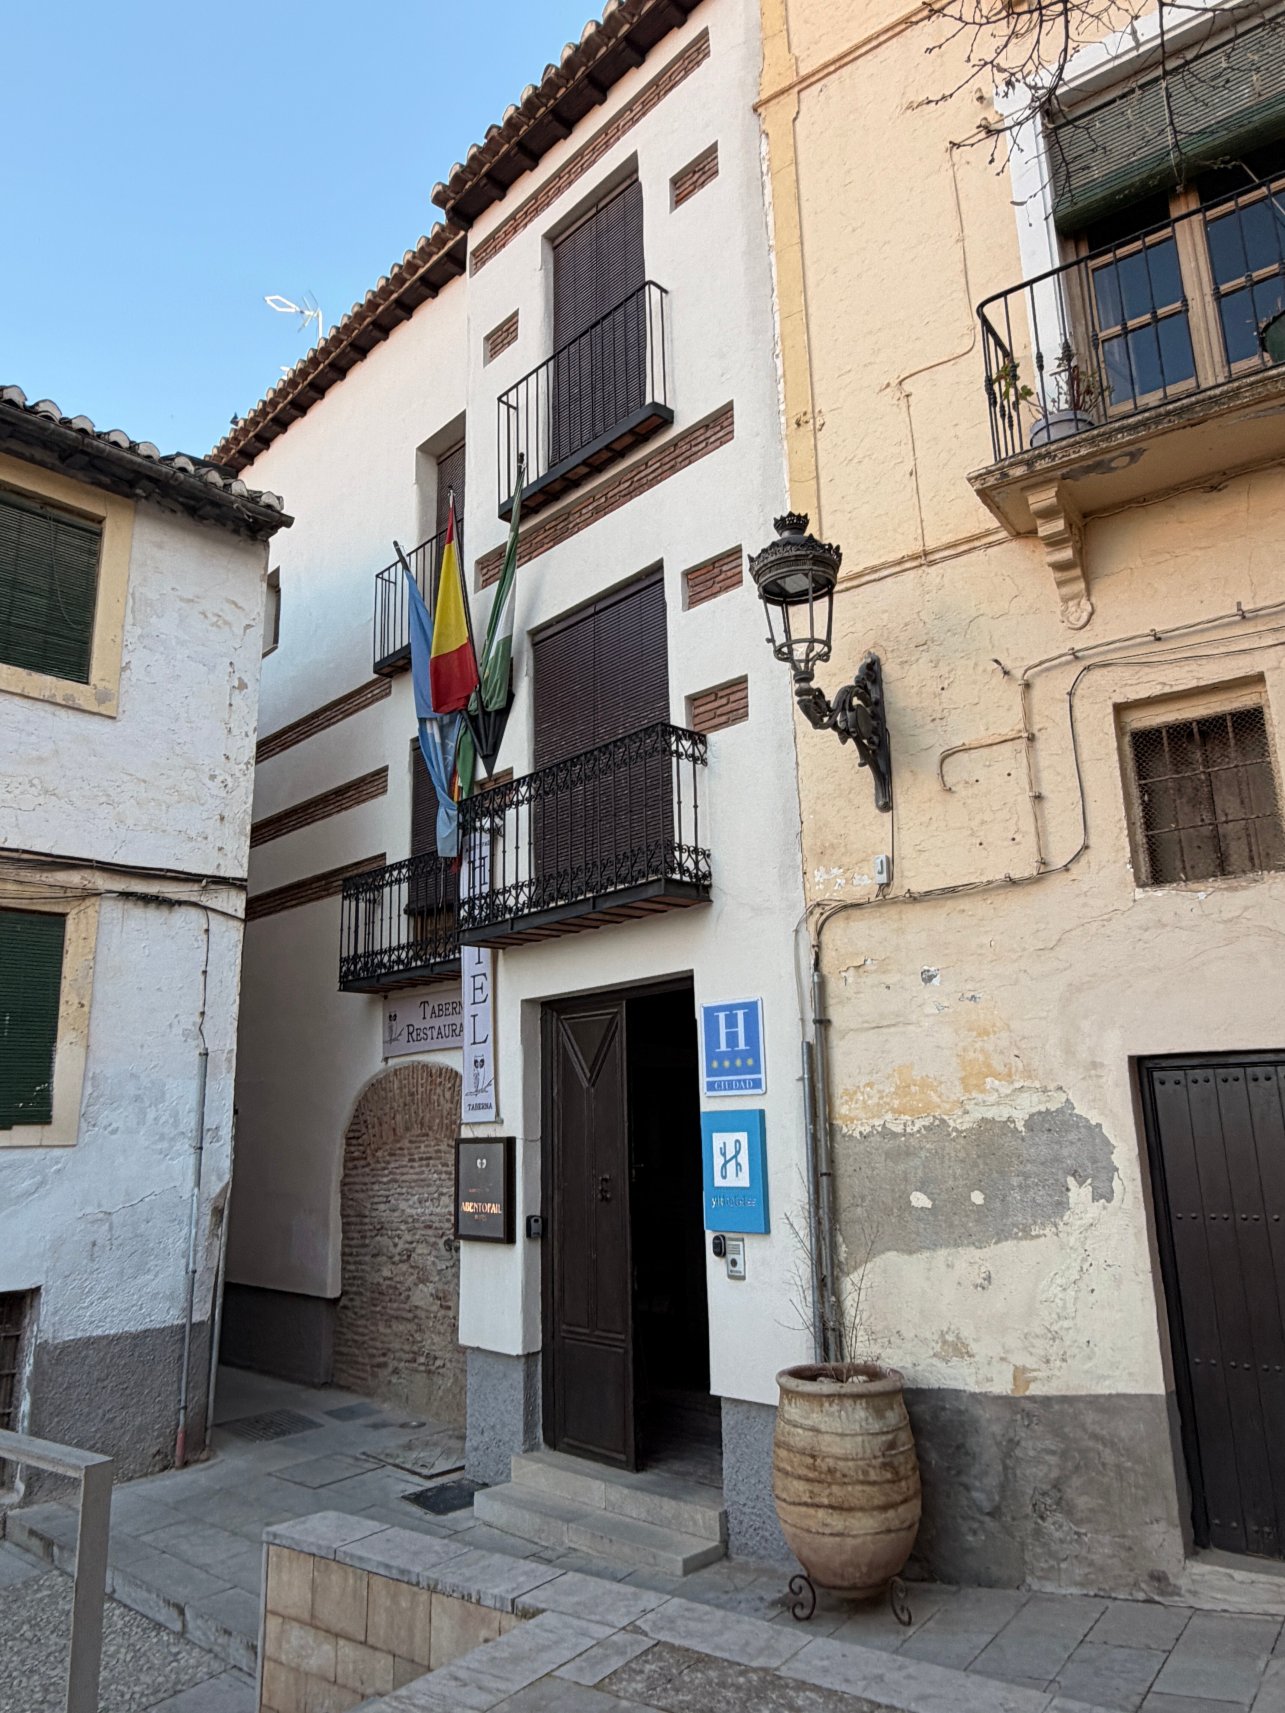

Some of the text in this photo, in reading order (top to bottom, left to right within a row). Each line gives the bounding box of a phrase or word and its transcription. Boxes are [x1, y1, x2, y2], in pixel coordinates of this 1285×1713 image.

[468, 855, 489, 1046] HTEL
[714, 1009, 751, 1052] H
[714, 1079, 753, 1090] CIUDAD
[467, 1103, 493, 1111] TABERNA
